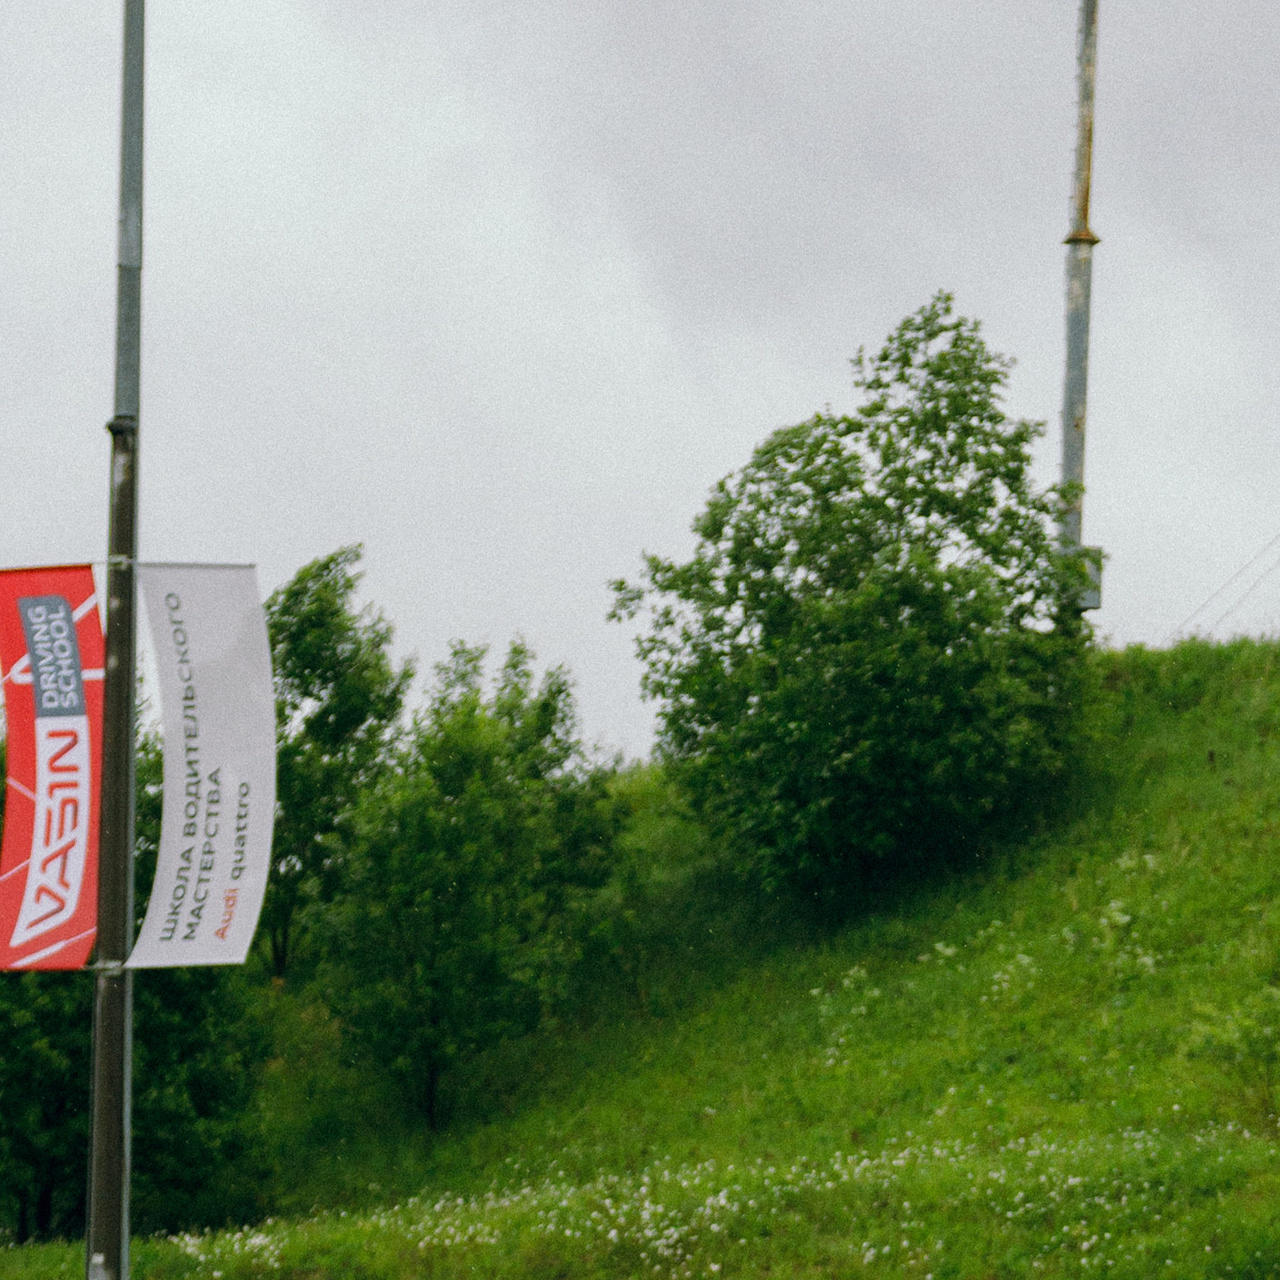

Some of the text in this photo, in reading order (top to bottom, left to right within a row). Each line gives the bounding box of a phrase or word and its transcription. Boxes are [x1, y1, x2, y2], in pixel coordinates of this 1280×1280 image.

[27, 605, 58, 709] DRIVING
[48, 604, 79, 709] SCHOOL
[159, 593, 200, 942] ШКОЛА ВОДИТЕЛЬСКОГО
[182, 766, 222, 941] МАСТЕРСТВА
[214, 781, 251, 941] Audi quattro
